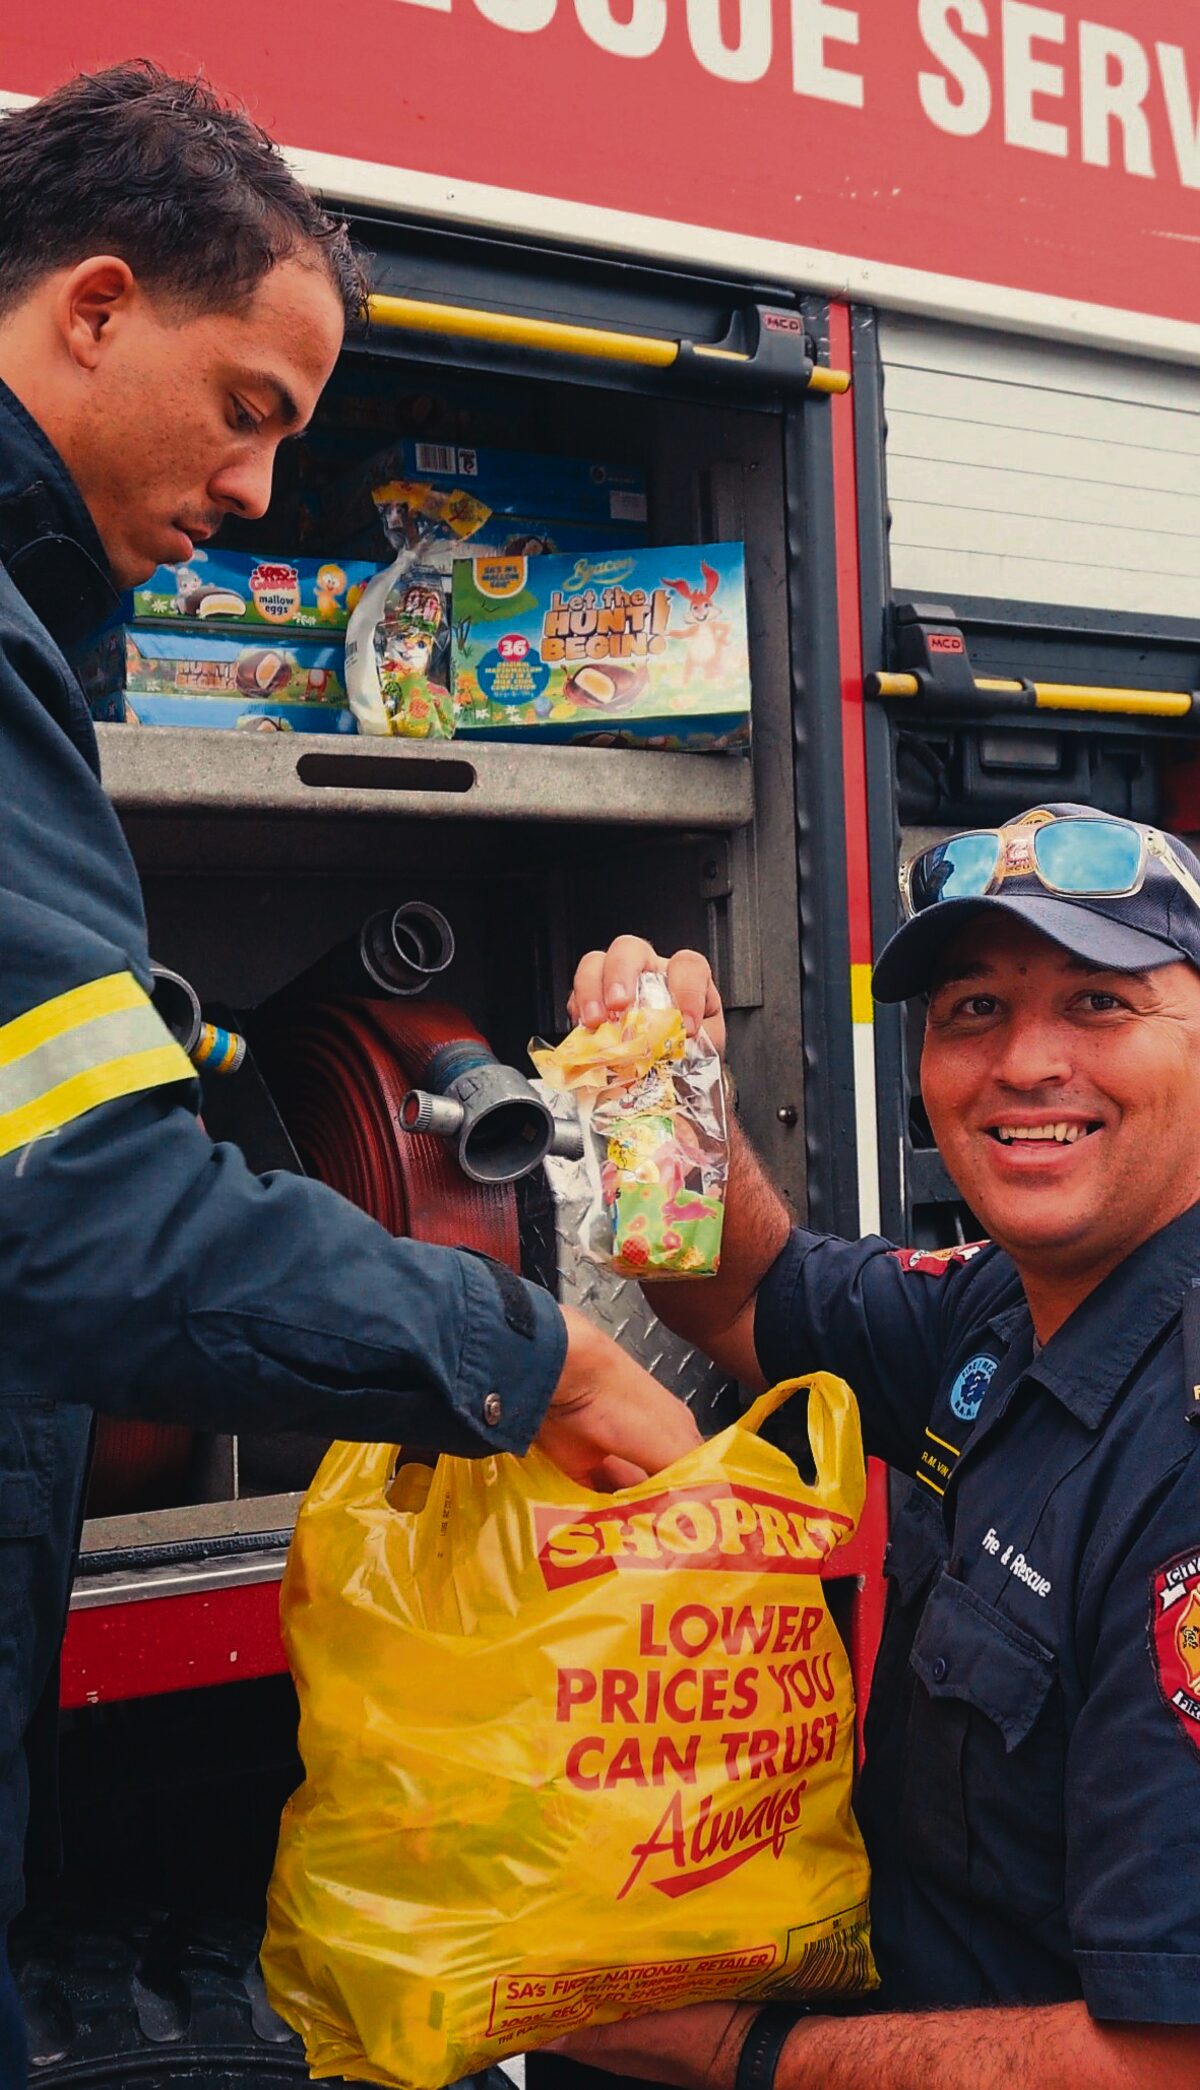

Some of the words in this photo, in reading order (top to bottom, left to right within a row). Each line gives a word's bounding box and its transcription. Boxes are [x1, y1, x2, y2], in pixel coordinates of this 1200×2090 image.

[767, 317, 799, 330] MCD
[258, 595, 294, 605] mallow
[264, 605, 288, 616] eggs
[551, 591, 596, 612] Let
[602, 586, 646, 609] the
[501, 639, 528, 657] 36
[931, 638, 961, 650] MCD
[1000, 1545, 1014, 1565] &
[1009, 1553, 1052, 1597] Rescue
[639, 1603, 824, 1658] LOWER
[555, 1667, 759, 1724] PRICES
[769, 1651, 836, 1713] YOU
[1179, 1696, 1200, 1721] FIR
[565, 1734, 702, 1792] CAN
[720, 1711, 840, 1783] TRUST
[616, 1779, 808, 1900] Always
[506, 1982, 547, 2000] SA's
[552, 1974, 601, 1996] FIRST
[602, 1962, 690, 1984] NATIONAL
[695, 1953, 769, 1972] RETAILER
